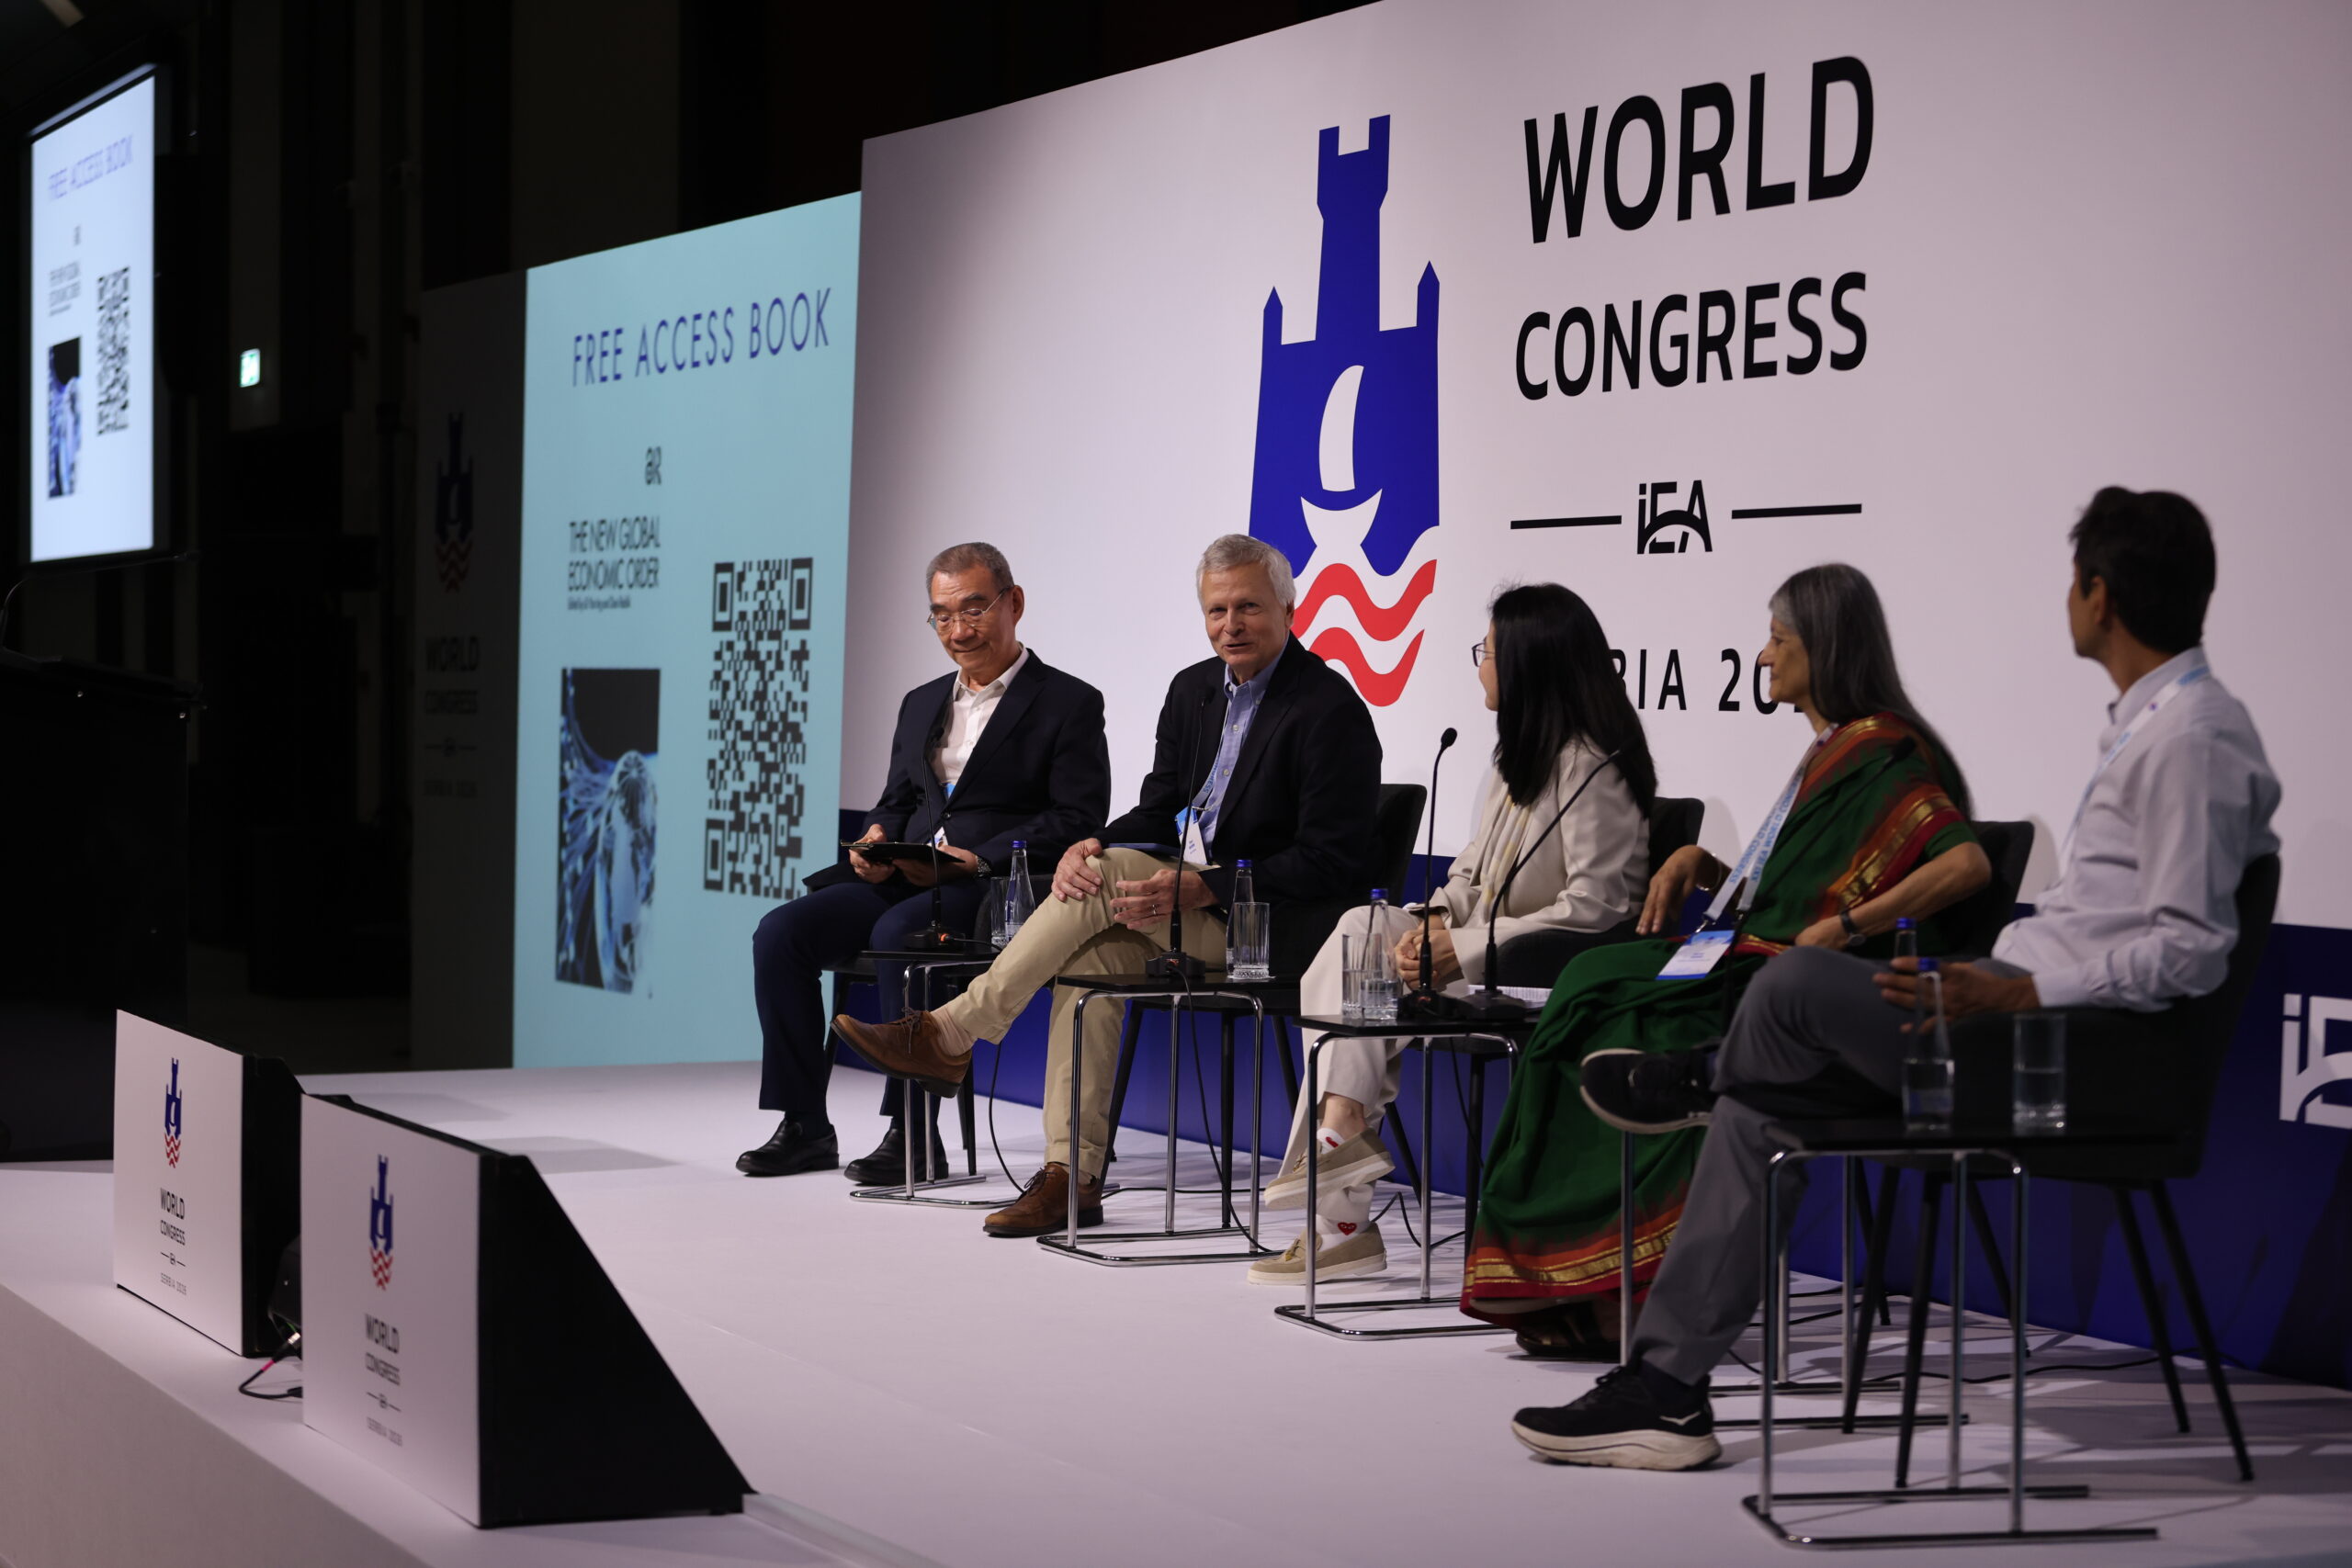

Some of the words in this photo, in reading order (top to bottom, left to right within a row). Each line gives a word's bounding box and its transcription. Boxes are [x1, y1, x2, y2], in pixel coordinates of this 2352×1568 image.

[1524, 55, 1874, 243] WORLD
[572, 327, 624, 387] FREE
[635, 306, 735, 378] ACCESS
[749, 287, 831, 359] BOOK
[1516, 271, 1868, 400] CONGRESS
[569, 520, 588, 552] THE
[591, 518, 617, 551] NEW
[618, 515, 661, 550] GLOBAL
[568, 558, 624, 591] ECONOMIC
[627, 557, 660, 589] ORDER
[1763, 813, 1783, 847] WORLD
[160, 1187, 185, 1220] WORLD
[365, 1313, 400, 1354] WORLD
